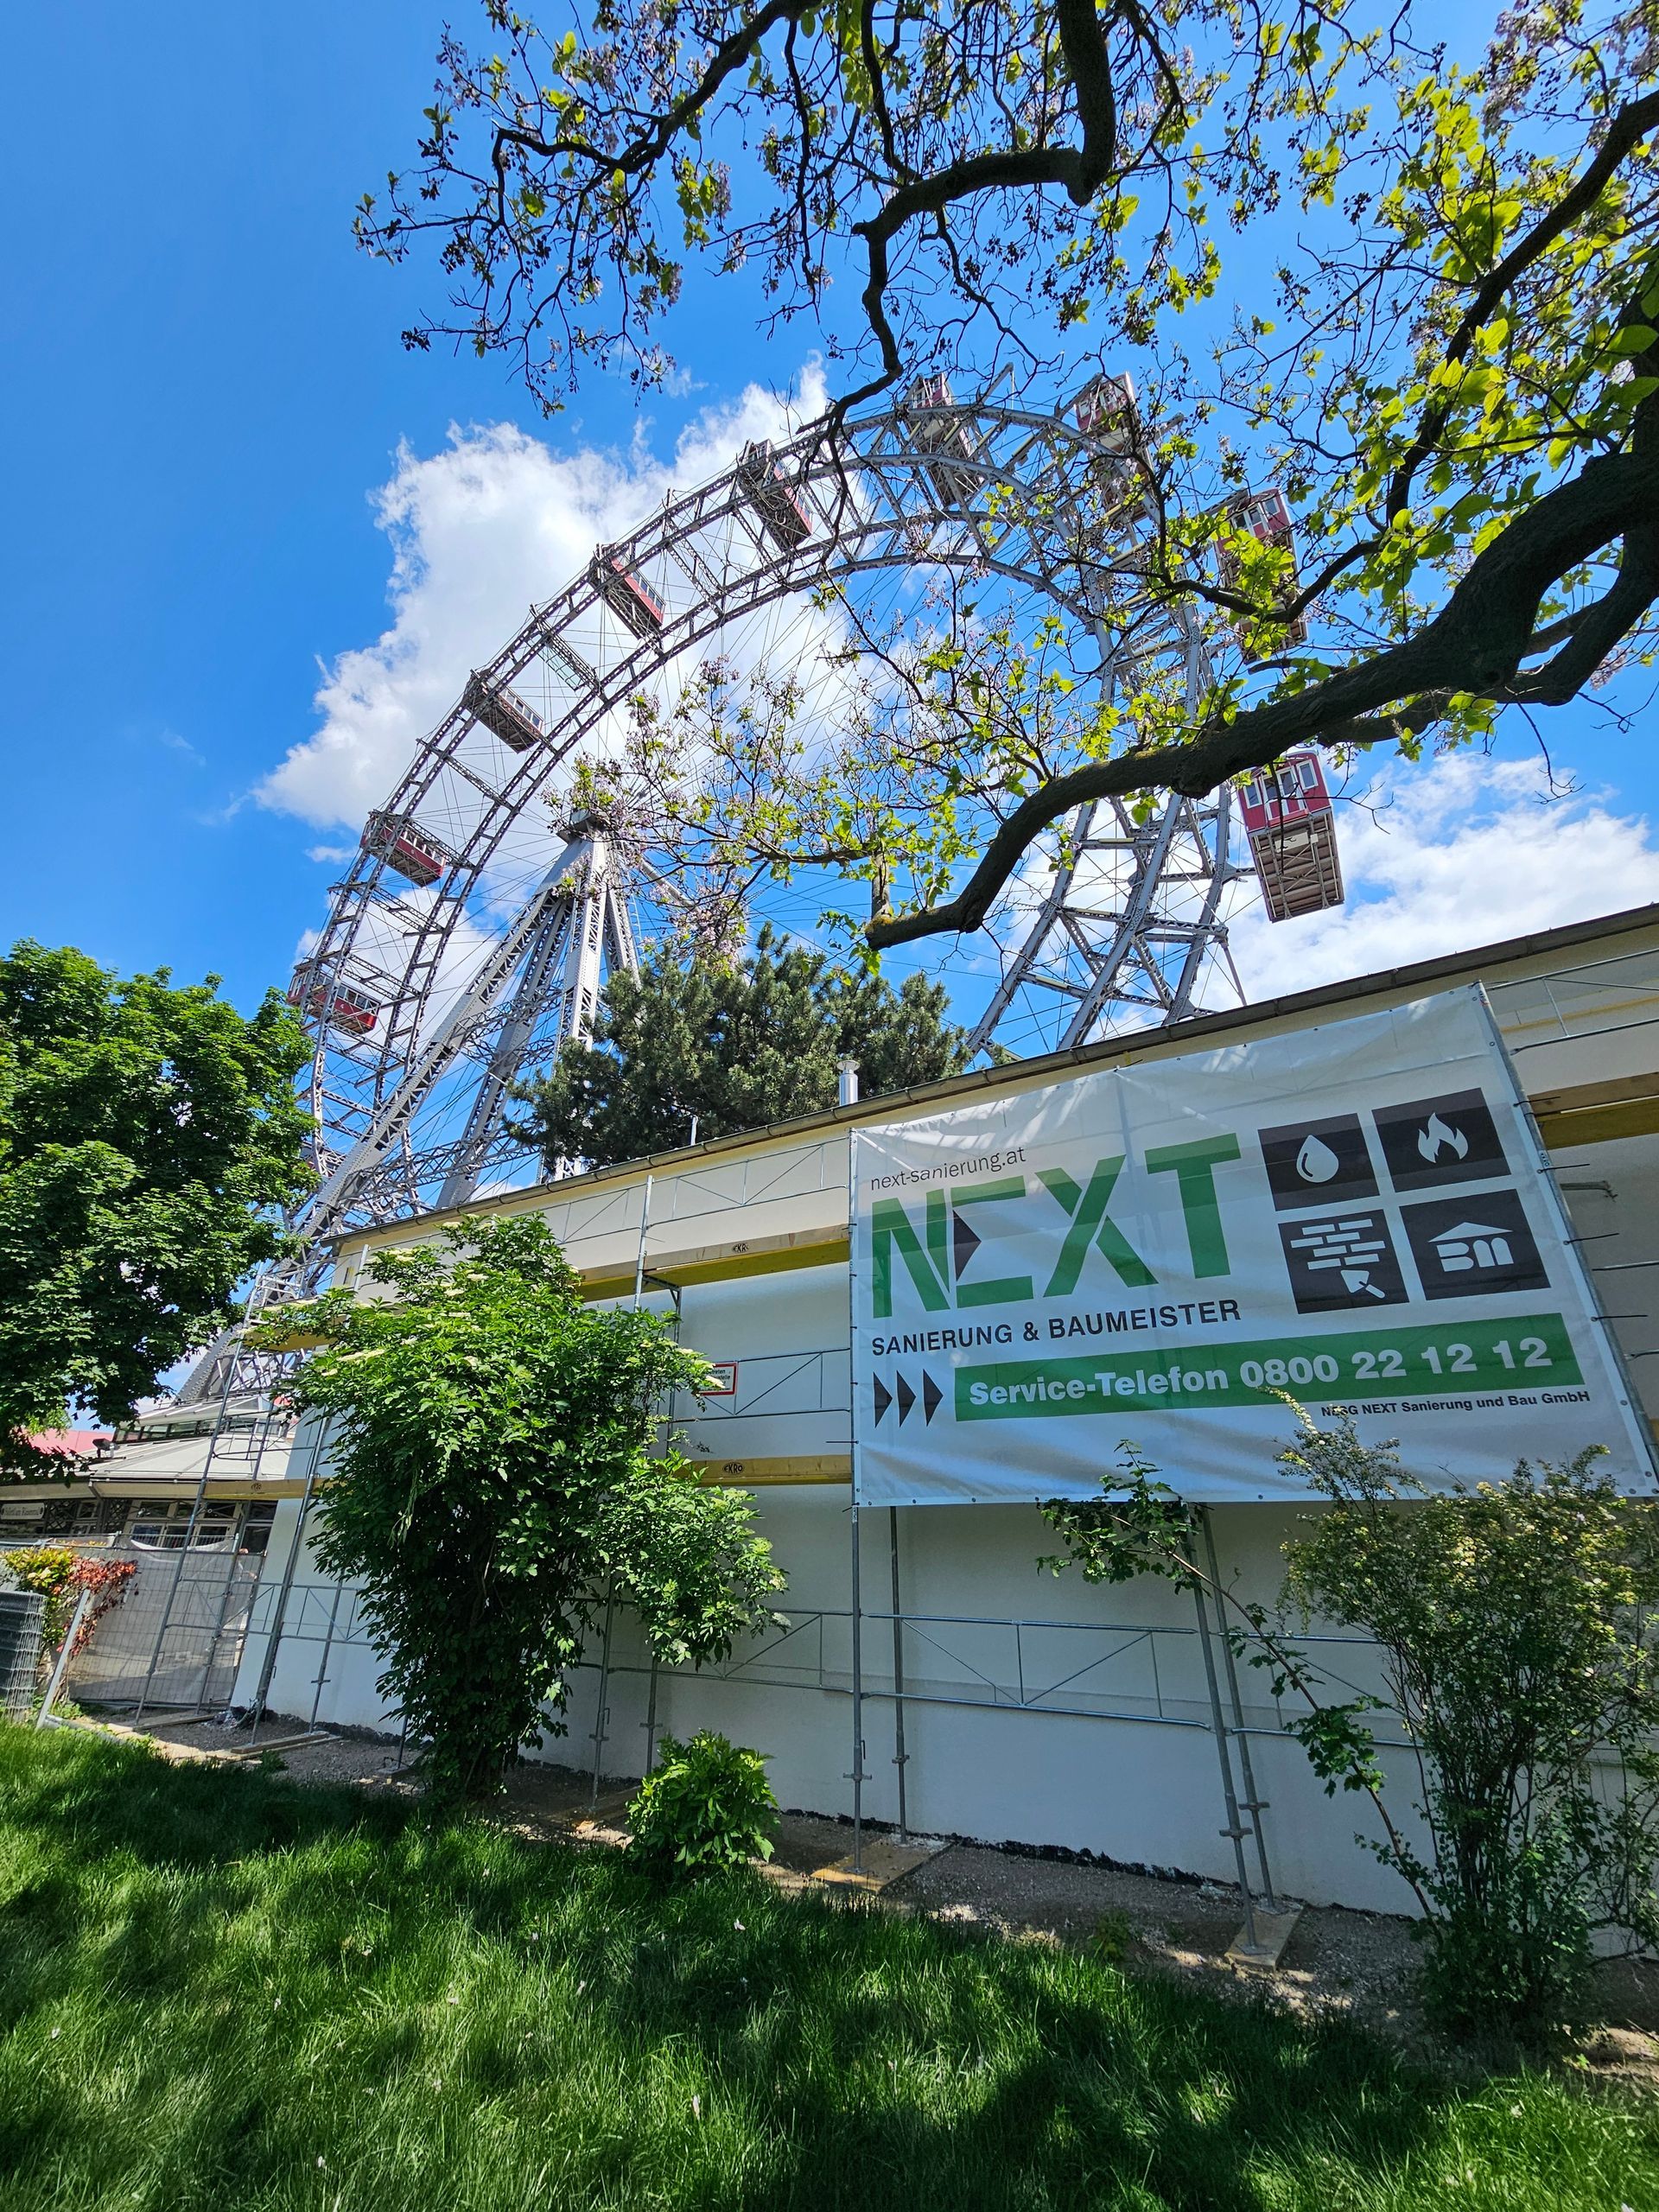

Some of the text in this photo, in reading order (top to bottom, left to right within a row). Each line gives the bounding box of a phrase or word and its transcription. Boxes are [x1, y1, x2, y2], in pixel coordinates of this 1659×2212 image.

[871, 1147, 1027, 1191] next-sanierung.at
[872, 1132, 1242, 1319] NEXT
[872, 1299, 1242, 1356] SANIERUNG & BAUMEISTER
[969, 1337, 1553, 1405] Service-Telefon 0800 22 12 12
[1362, 1402, 1397, 1414] NEXT
[1402, 1399, 1473, 1412] Sanierung
[1477, 1396, 1504, 1408] und
[1508, 1395, 1538, 1406] Bau
[1541, 1391, 1591, 1405] GmbH
[724, 1463, 743, 1474] EKRO
